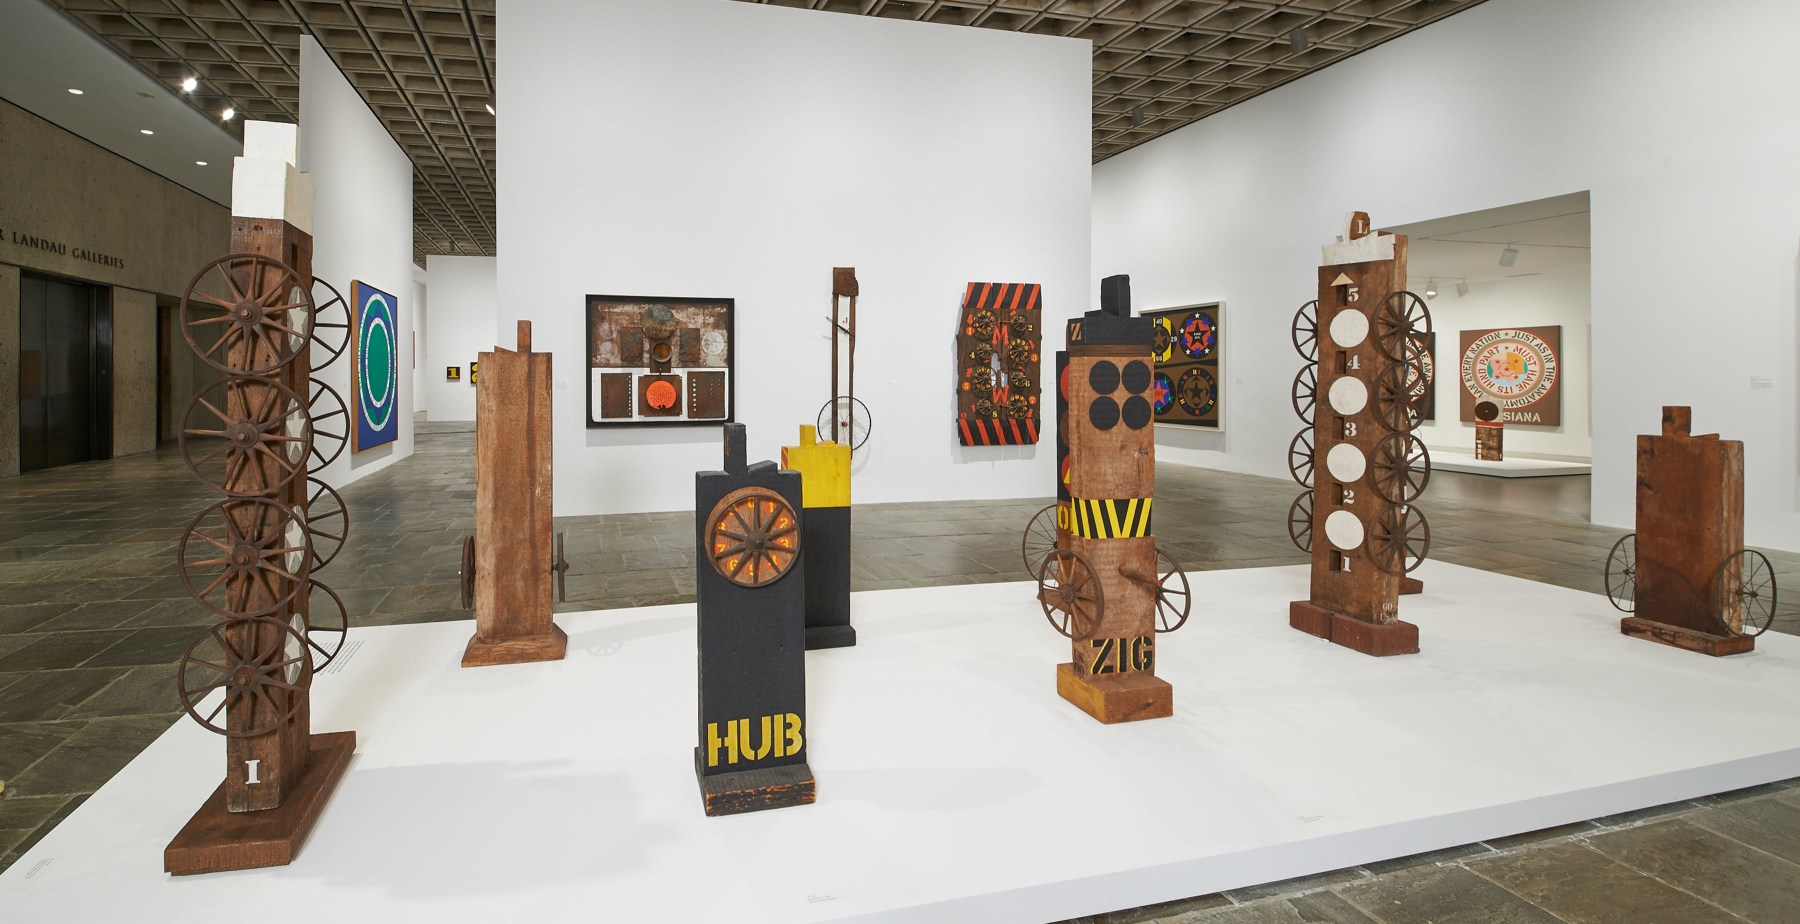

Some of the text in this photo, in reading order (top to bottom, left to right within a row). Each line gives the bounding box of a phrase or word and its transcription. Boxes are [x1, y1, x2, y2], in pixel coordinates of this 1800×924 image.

[13, 231, 67, 256] LANDAU
[72, 247, 125, 269] GALLERIES
[1348, 287, 1359, 302] 5
[991, 324, 1009, 345] M
[1468, 331, 1501, 355] NATION
[1512, 331, 1537, 343] JUST
[1534, 342, 1549, 354] AS
[1347, 355, 1360, 370] 4
[1544, 353, 1555, 363] IN
[448, 367, 459, 379] 1
[1462, 355, 1474, 382] EVERY
[1478, 345, 1538, 394] MUST HAVE ITS HIND PART
[1543, 366, 1555, 384] THE
[992, 385, 1009, 404] W
[1504, 383, 1548, 408] ANATOMY
[1503, 411, 1541, 423] SIANA
[1344, 422, 1357, 437] 3
[1343, 489, 1355, 504] 2
[1342, 556, 1351, 573] 1
[1382, 602, 1393, 611] GO
[1090, 635, 1153, 676] ZIG
[707, 712, 803, 768] HUB
